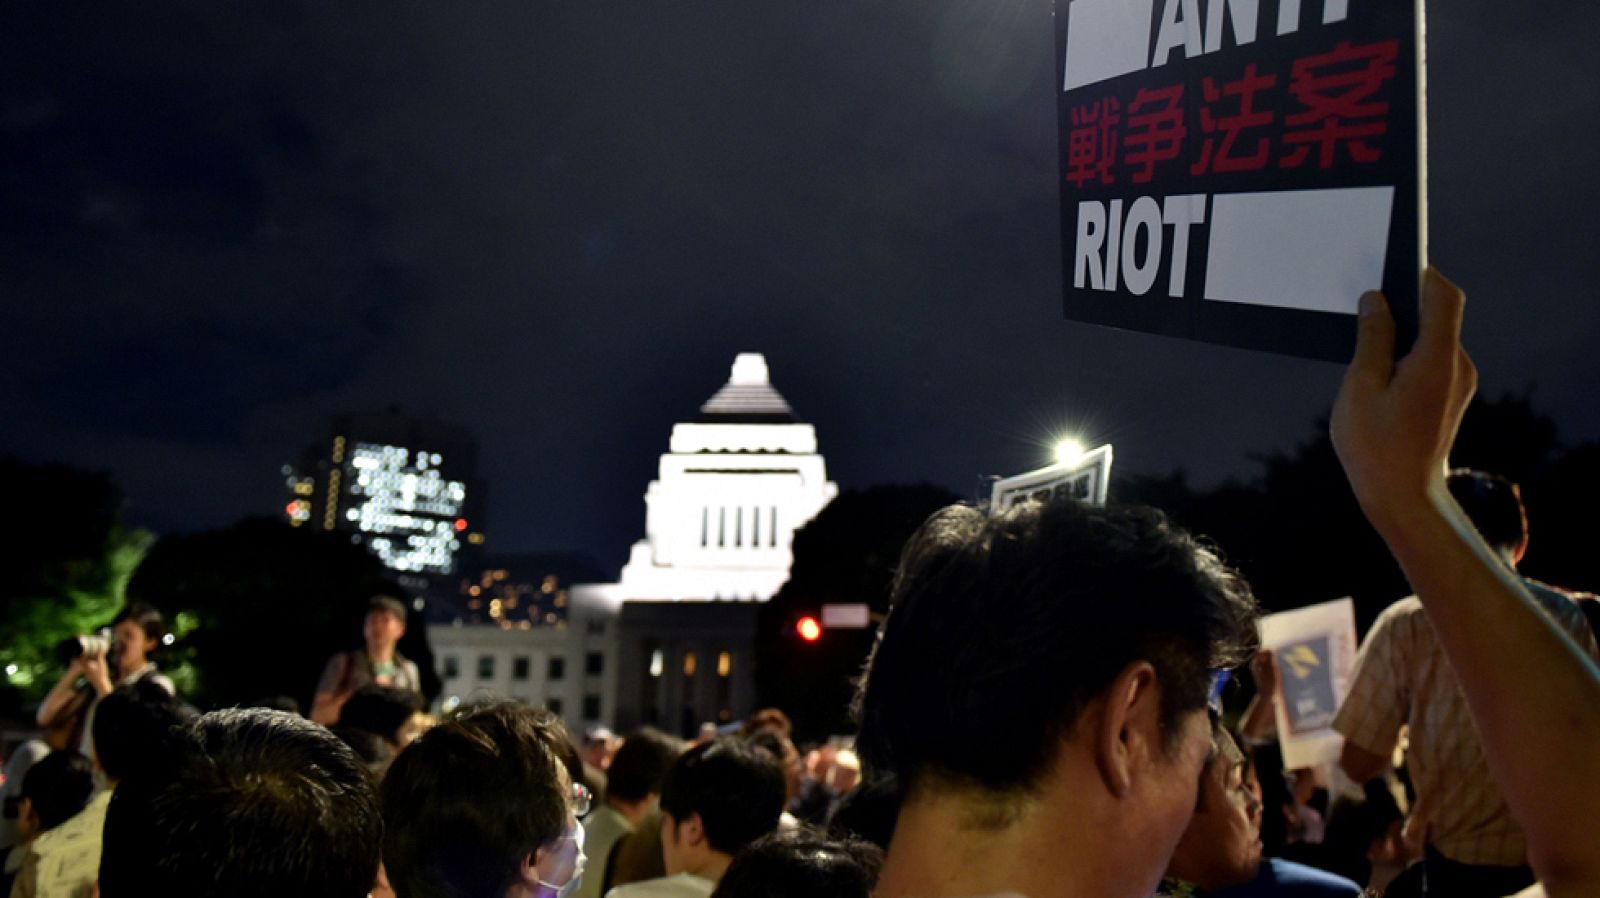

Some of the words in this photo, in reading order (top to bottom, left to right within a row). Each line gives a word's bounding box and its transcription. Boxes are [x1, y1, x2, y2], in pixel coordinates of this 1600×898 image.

[1151, 0, 1348, 68] AN
[1066, 40, 1399, 188] 戦争法案
[1074, 194, 1207, 299] RIOT
